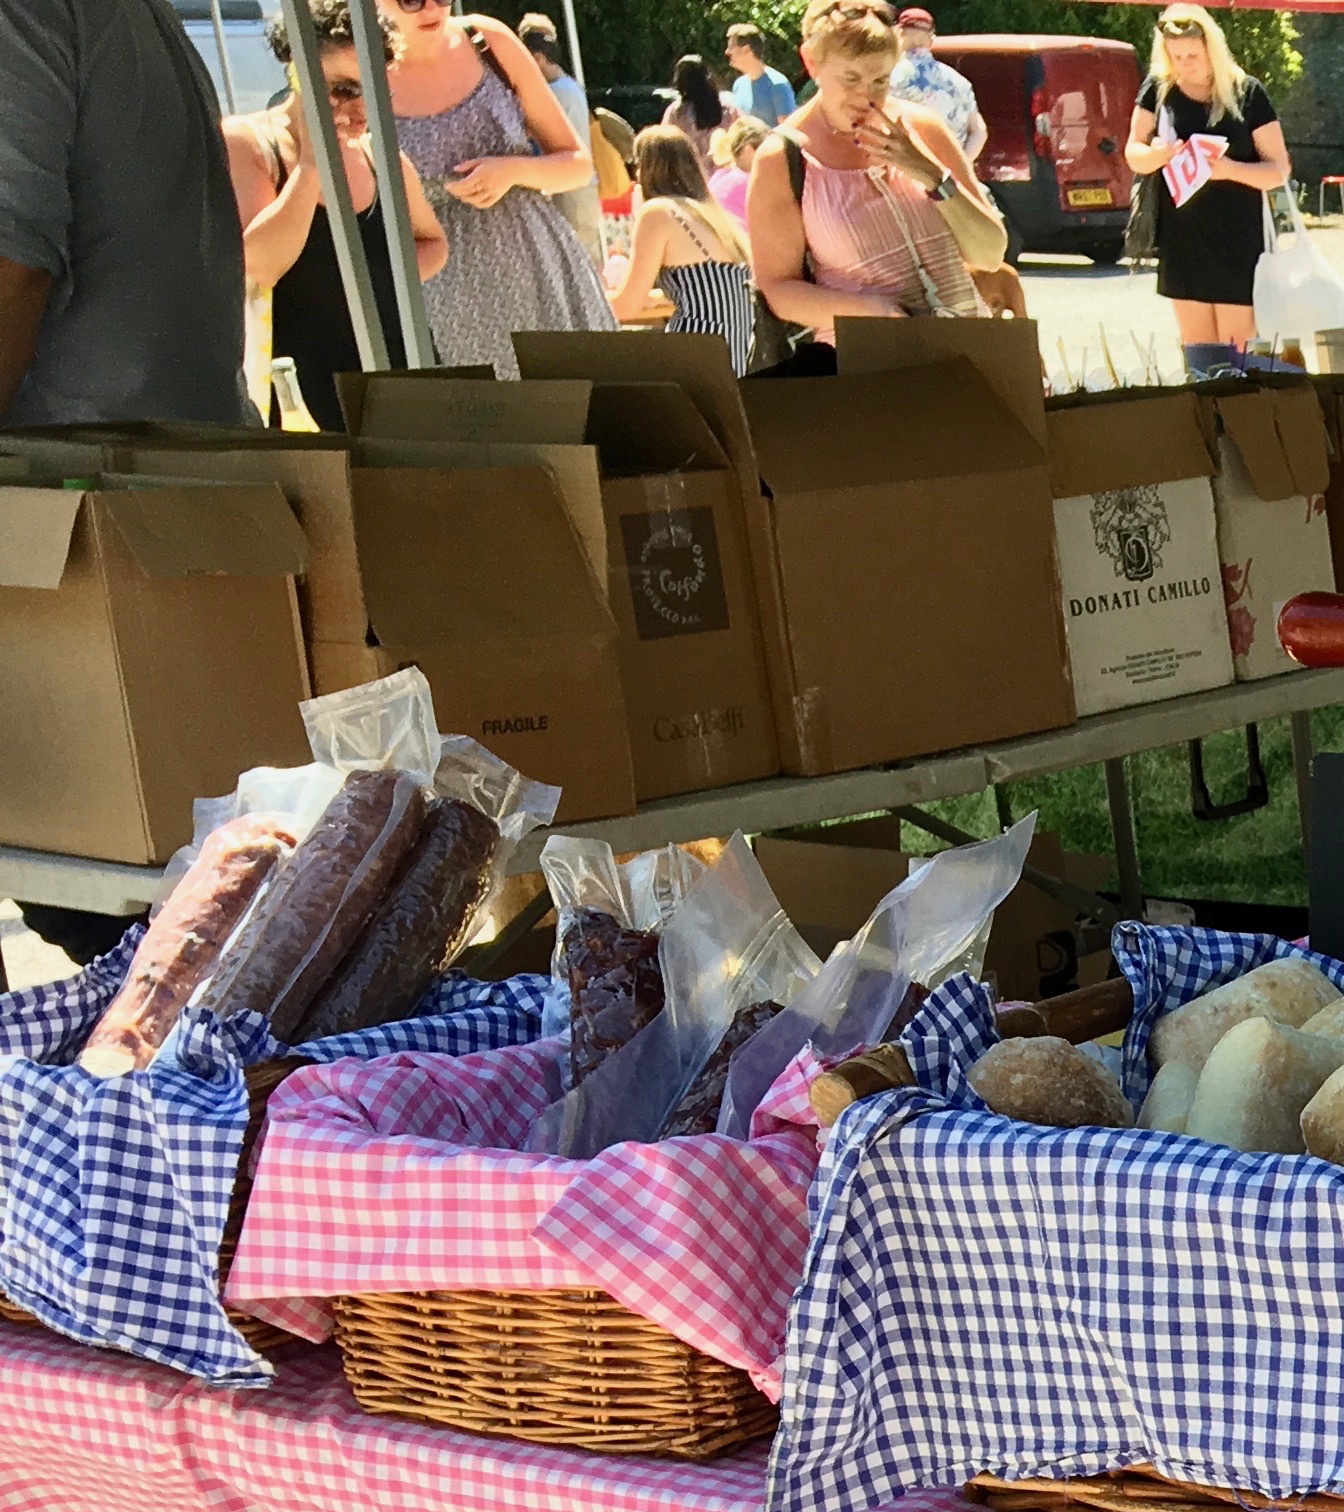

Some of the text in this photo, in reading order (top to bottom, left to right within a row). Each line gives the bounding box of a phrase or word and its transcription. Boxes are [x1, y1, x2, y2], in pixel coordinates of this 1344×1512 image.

[1069, 576, 1212, 618] DONATI CAMILLO
[481, 714, 549, 736] FRAGILE
